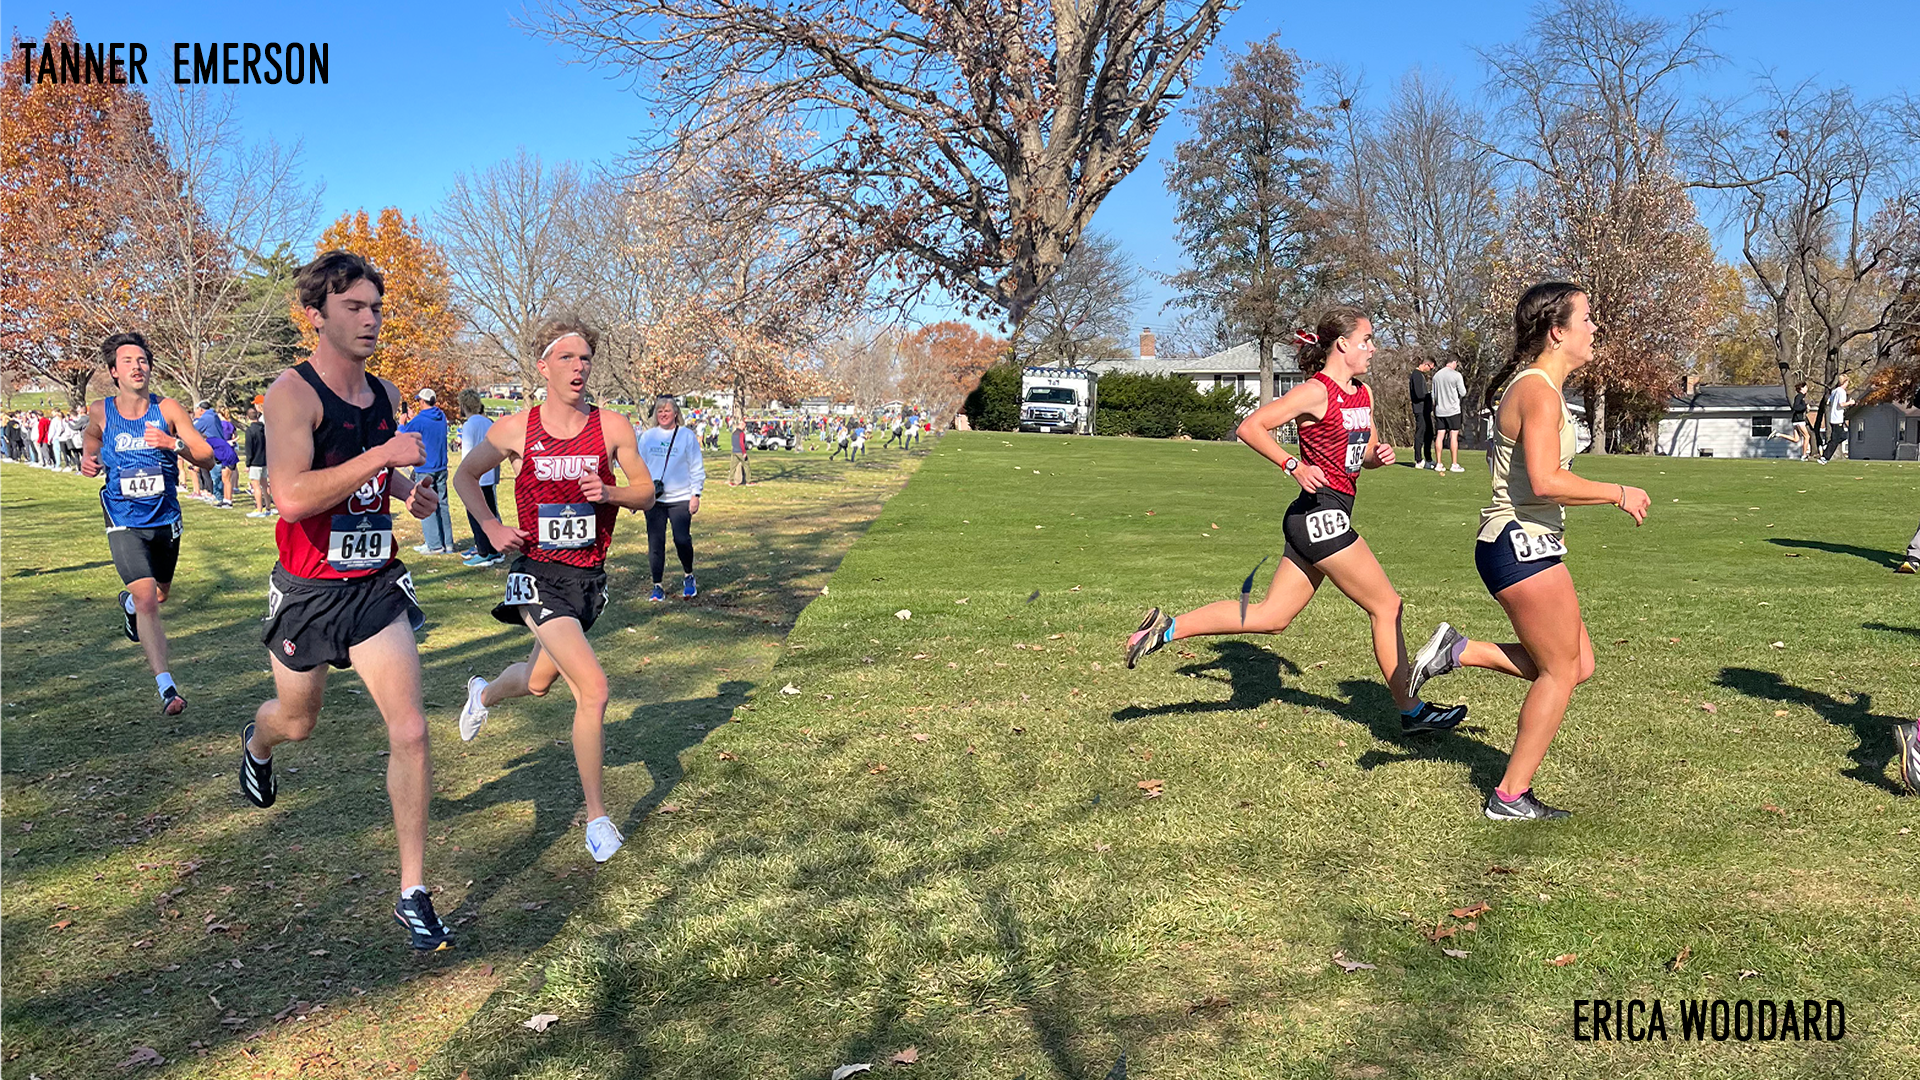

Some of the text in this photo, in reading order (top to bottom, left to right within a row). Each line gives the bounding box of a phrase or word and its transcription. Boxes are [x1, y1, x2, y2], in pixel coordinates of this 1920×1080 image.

[1340, 407, 1371, 429] SIU
[129, 478, 156, 493] 447
[548, 518, 587, 541] 643
[1309, 511, 1347, 539] 364
[341, 532, 382, 559] 649
[506, 575, 534, 602] 643
